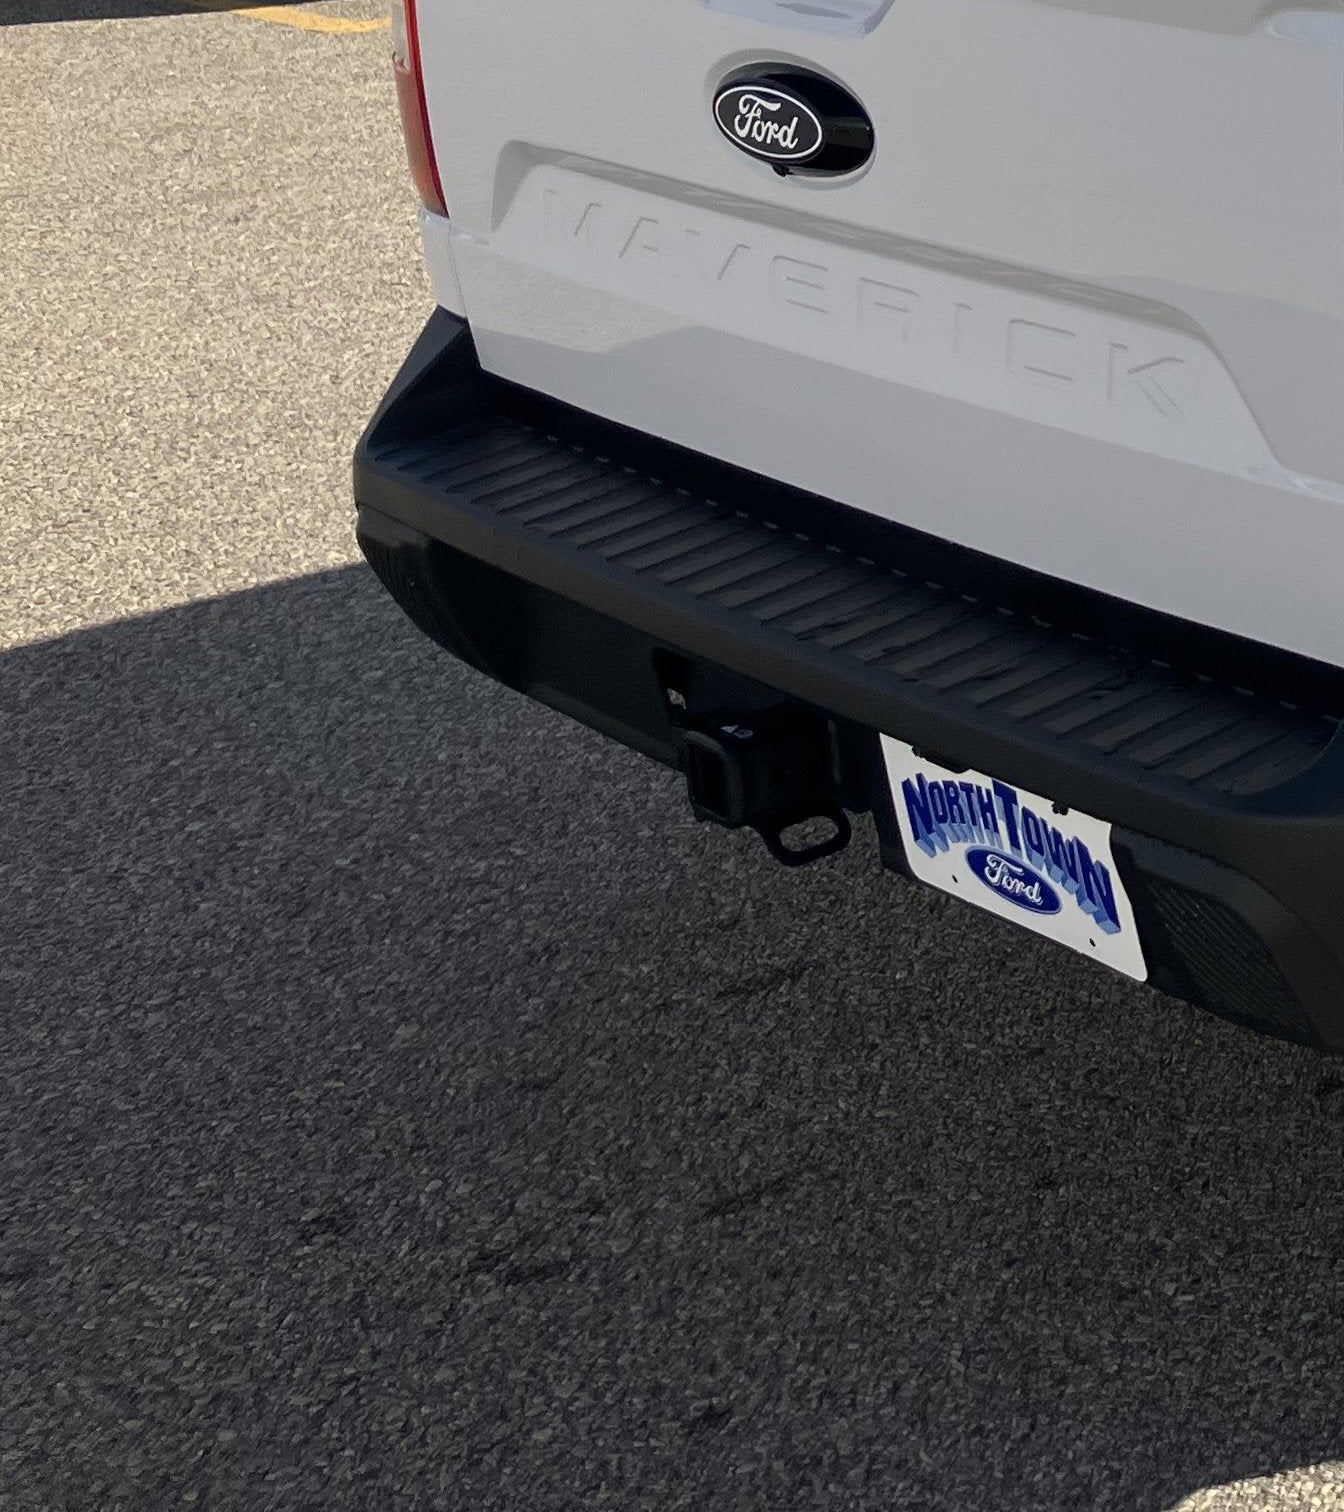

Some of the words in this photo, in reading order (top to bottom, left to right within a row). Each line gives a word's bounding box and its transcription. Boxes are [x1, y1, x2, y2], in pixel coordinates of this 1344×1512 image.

[734, 94, 799, 149] Ford
[541, 187, 1186, 418] MAVERICK
[984, 853, 1044, 905] Ford
